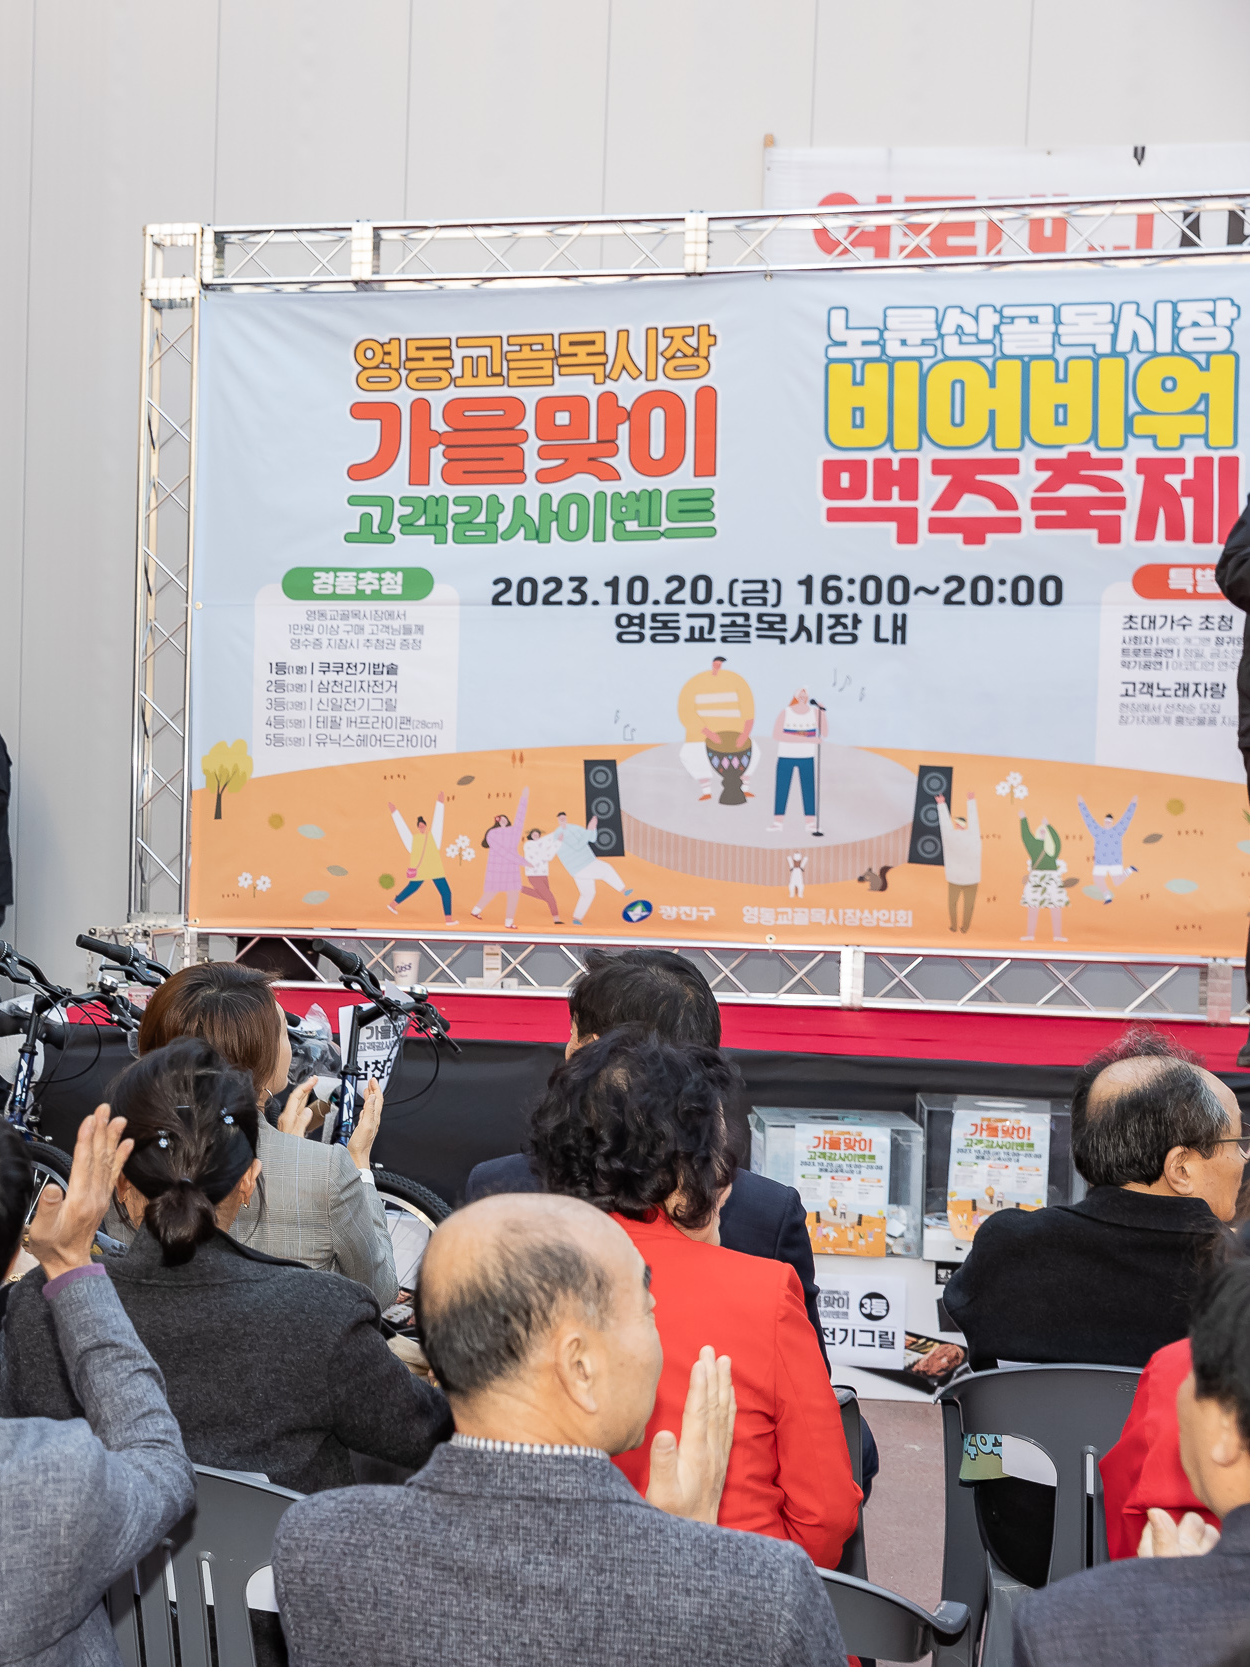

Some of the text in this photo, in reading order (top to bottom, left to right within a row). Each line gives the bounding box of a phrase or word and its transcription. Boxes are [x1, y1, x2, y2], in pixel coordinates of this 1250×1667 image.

[825, 297, 1241, 359] 노룬산골목시장
[354, 325, 716, 391] 영동교골목시장
[824, 352, 1239, 451] 비어비워
[347, 386, 717, 485] 가을맞이
[822, 451, 1239, 545] 맥주축제
[344, 488, 716, 543] 고객감사이벤트
[312, 571, 403, 595] 경품추첨
[492, 574, 1063, 608] 2023.10.20.(금) 16:00~20:00
[306, 610, 406, 621] 영동교골목시장에서
[1122, 615, 1233, 631] 초대가수 초청
[317, 624, 340, 636] 이상
[342, 624, 365, 636] 구매
[368, 624, 425, 636] 고객님들께
[615, 612, 908, 645] 영동교골목시장 내
[290, 638, 422, 650] 영수증 지참시 추첨권 증정
[1121, 648, 1174, 659] 트로트공연
[318, 662, 399, 676] 쿠쿠전기밥솥
[1120, 660, 1163, 671] 악기공연
[317, 680, 398, 694] 삼천리자전거
[1119, 681, 1227, 699] 고객노래자랑
[317, 697, 397, 712] 신일전기그릴
[316, 716, 342, 730] 테팔
[315, 734, 437, 749] 유닉스헤어드라이어
[659, 904, 913, 928] 광진구 영동교골목시장상인회
[813, 1136, 873, 1152] 가을맞이
[860, 1298, 889, 1316] 3등
